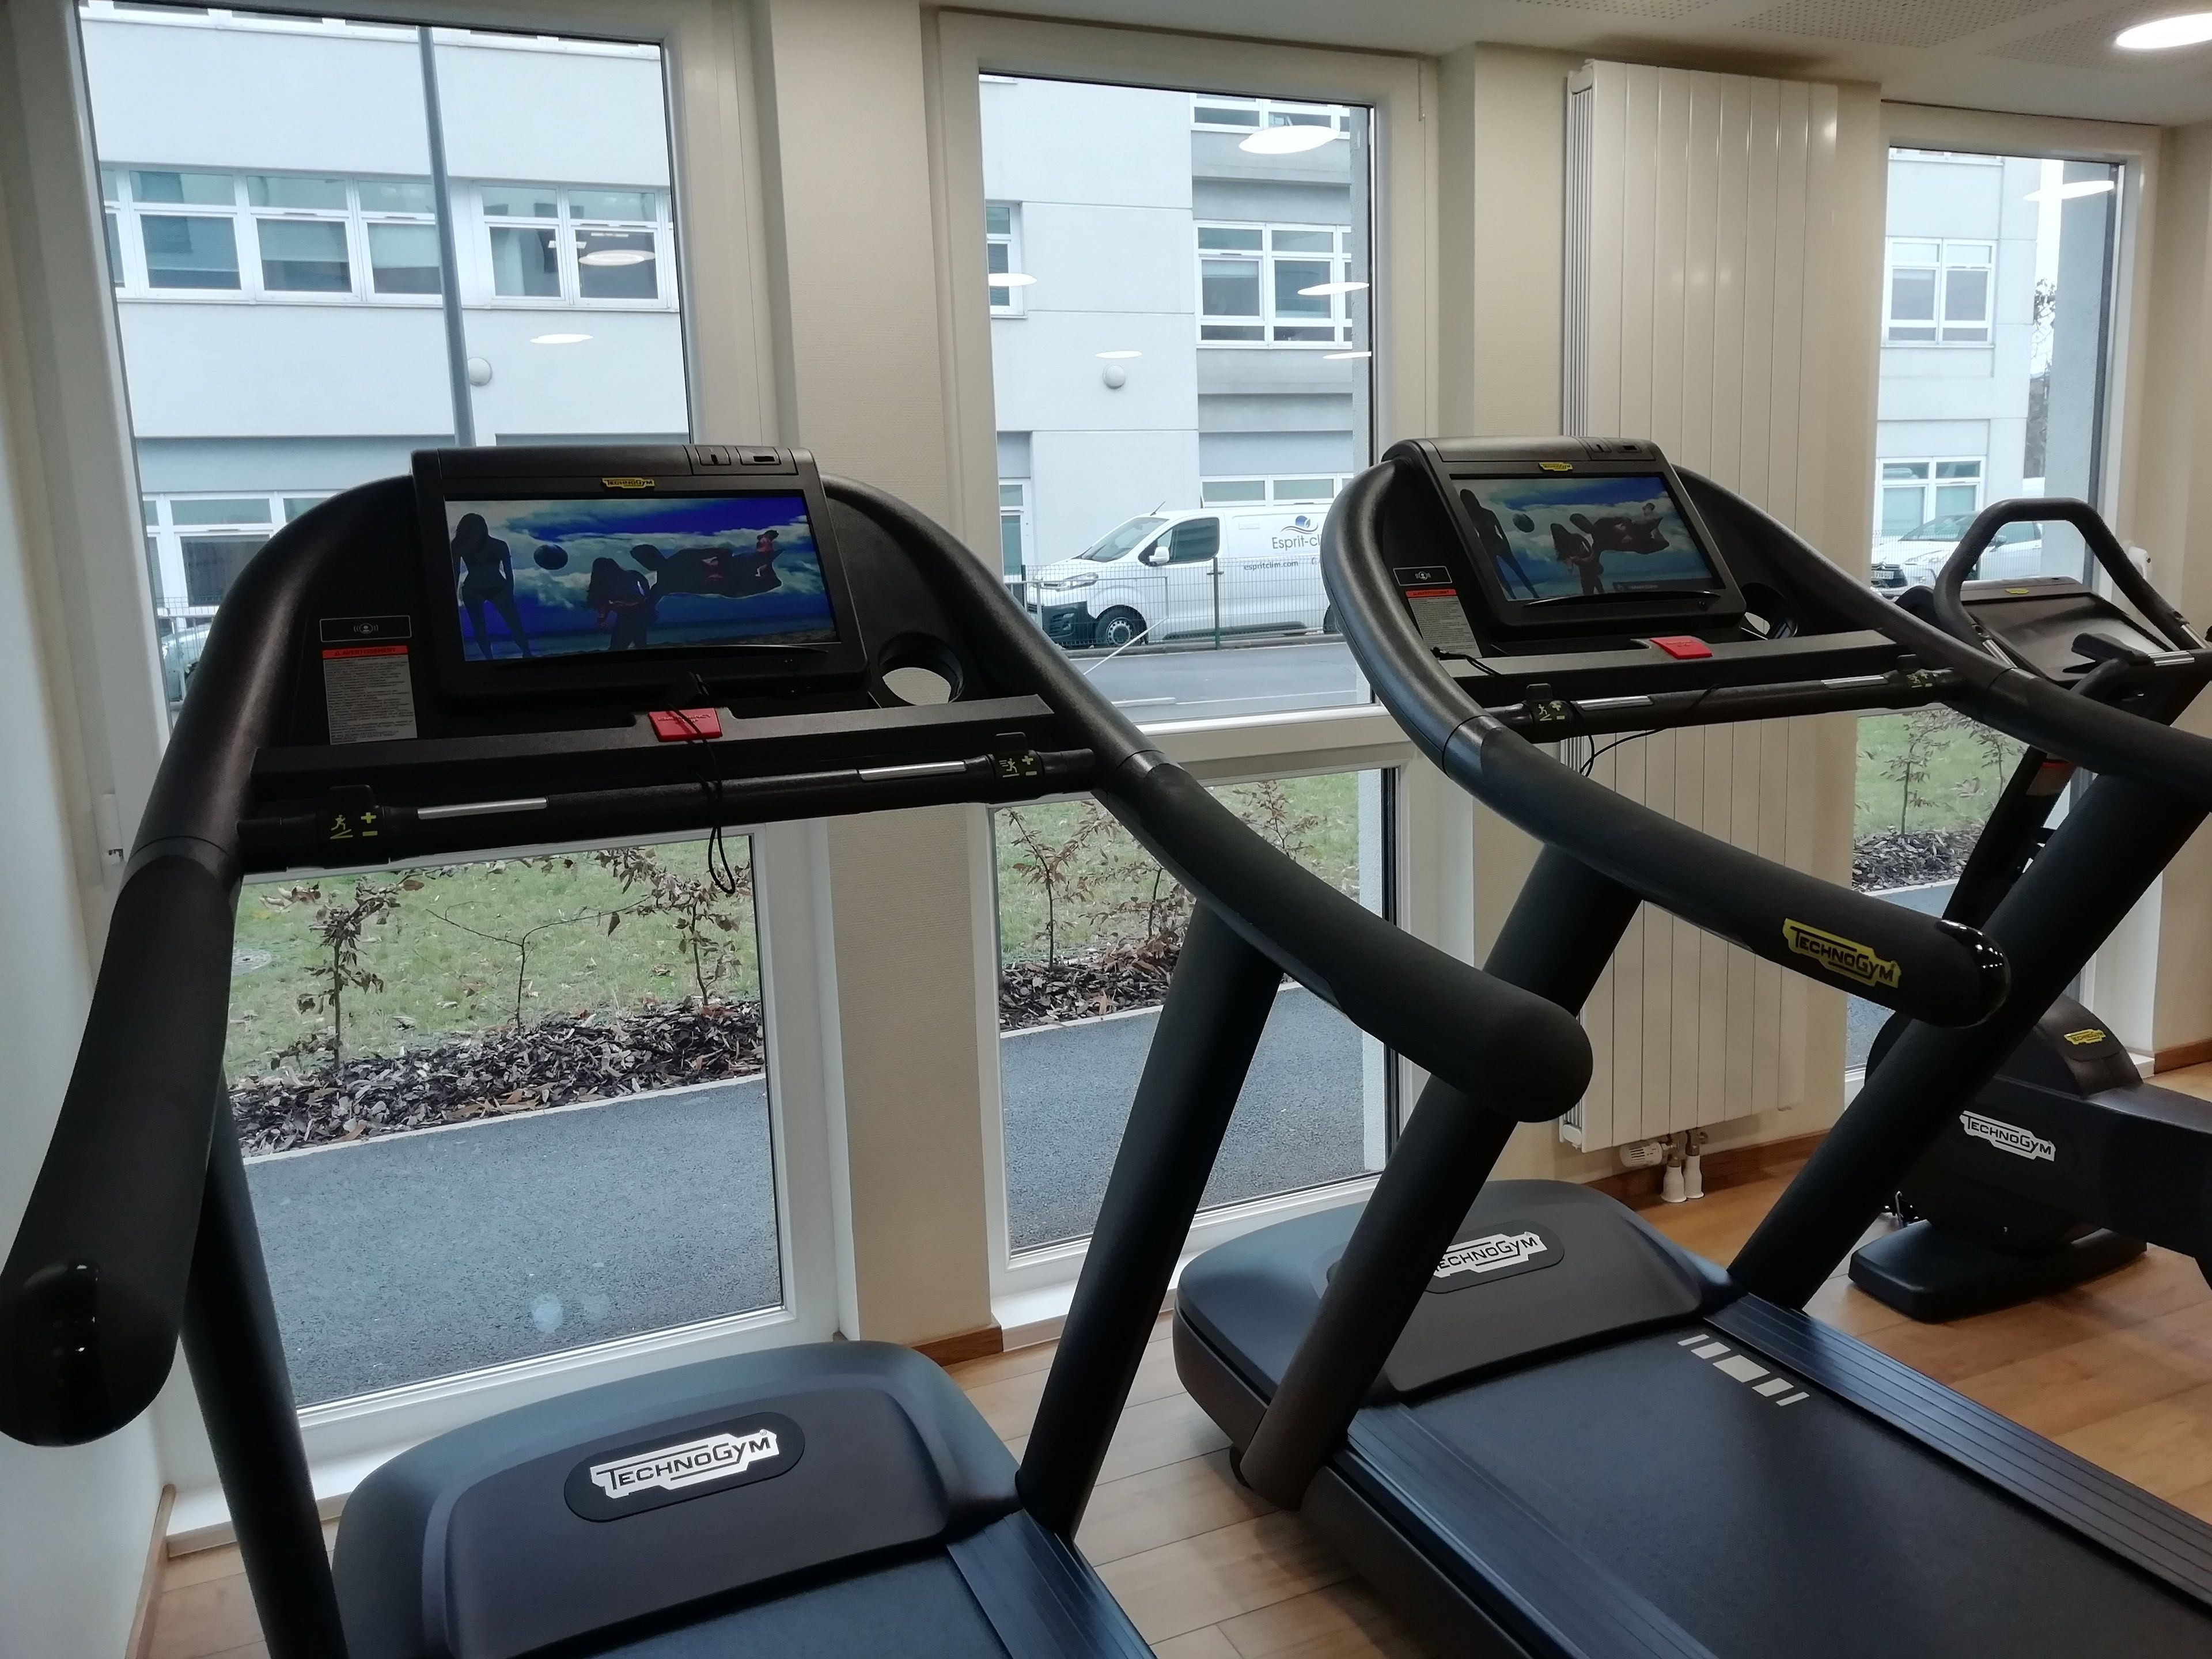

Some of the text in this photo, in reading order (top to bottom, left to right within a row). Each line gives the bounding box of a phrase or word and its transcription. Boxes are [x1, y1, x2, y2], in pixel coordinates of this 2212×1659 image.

[1271, 534, 1321, 551] Esprit-cl
[1244, 560, 1298, 571] espritclim.com
[1435, 1237, 1539, 1272] ECHNOGYM
